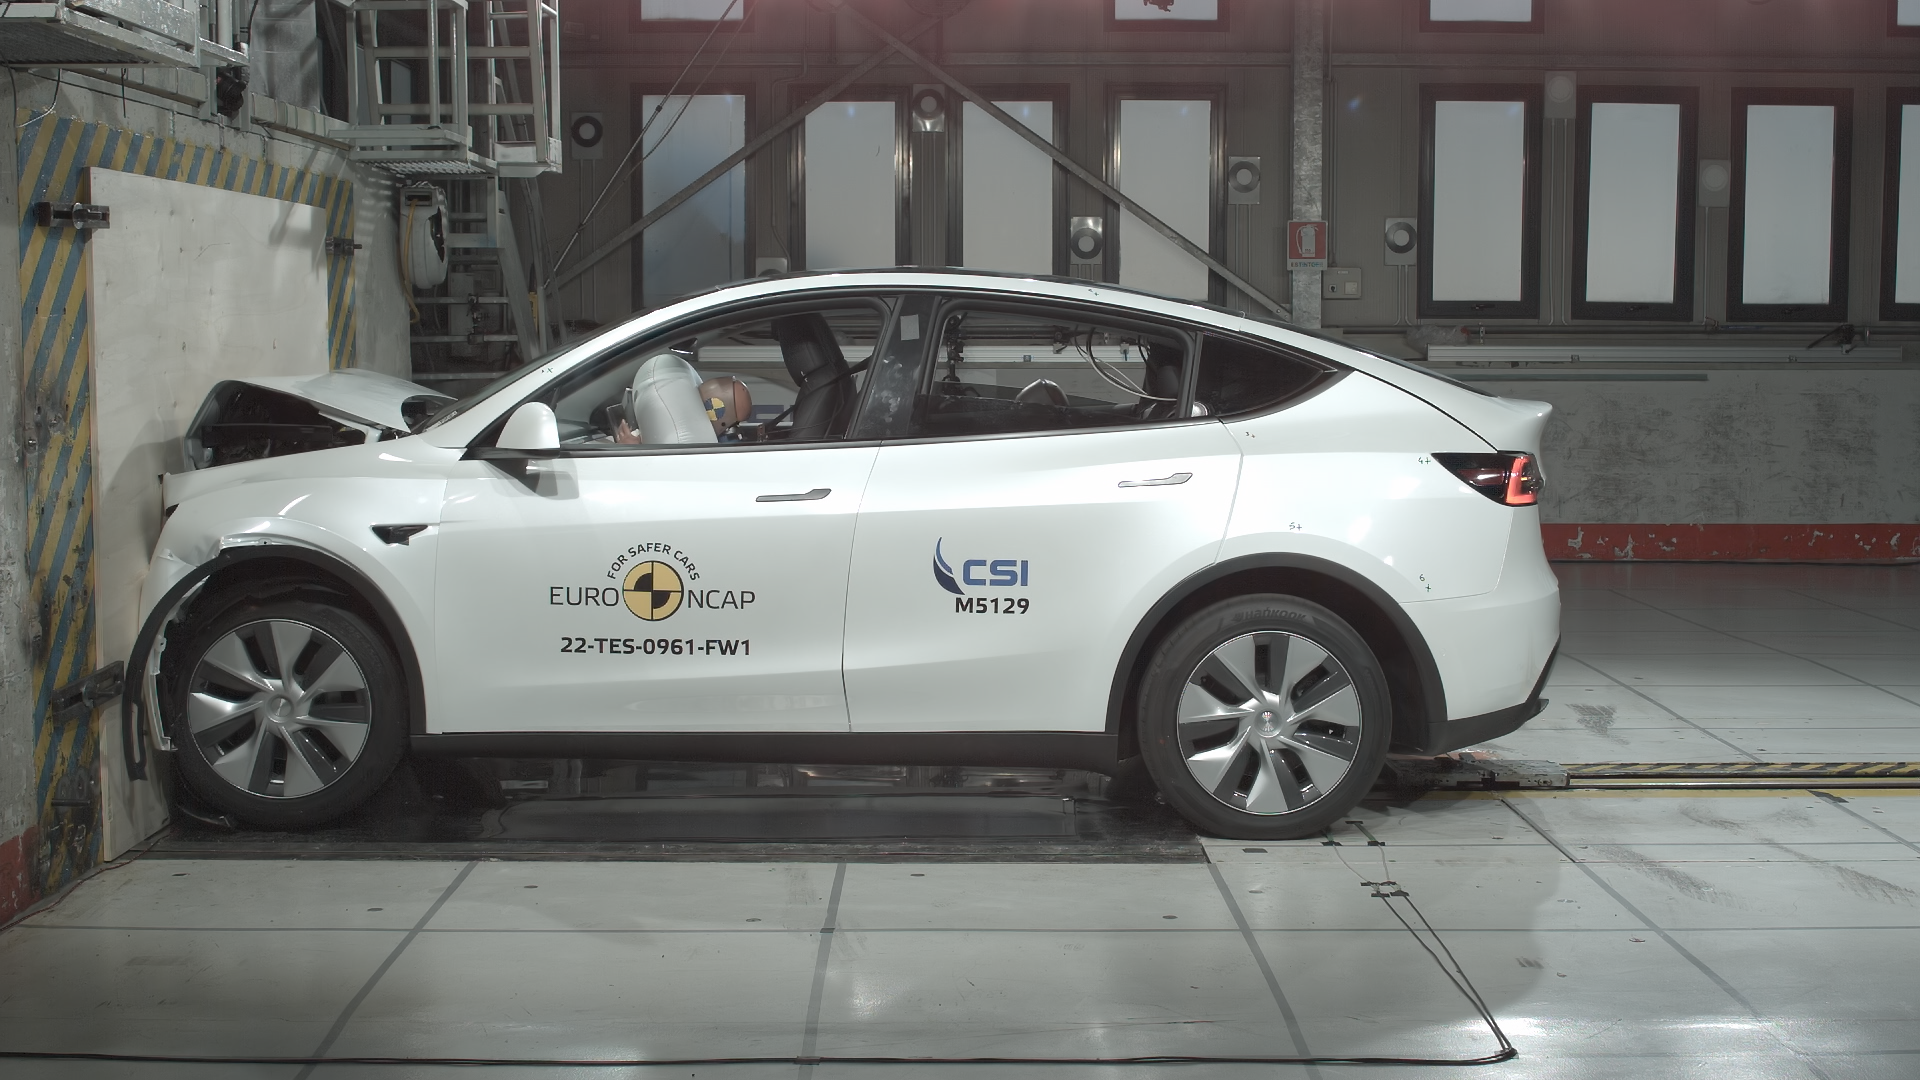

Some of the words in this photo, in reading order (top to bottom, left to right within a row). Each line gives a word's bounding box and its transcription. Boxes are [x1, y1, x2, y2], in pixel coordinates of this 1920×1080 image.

[606, 554, 628, 580] FOR
[627, 542, 672, 558] SAFER
[673, 550, 700, 581] CARS
[962, 559, 1029, 586] CSI
[550, 586, 619, 607] EURO
[688, 589, 756, 610] NCAP
[955, 597, 1030, 614] M5129
[560, 636, 751, 656] 22-TES-0961-FW1
